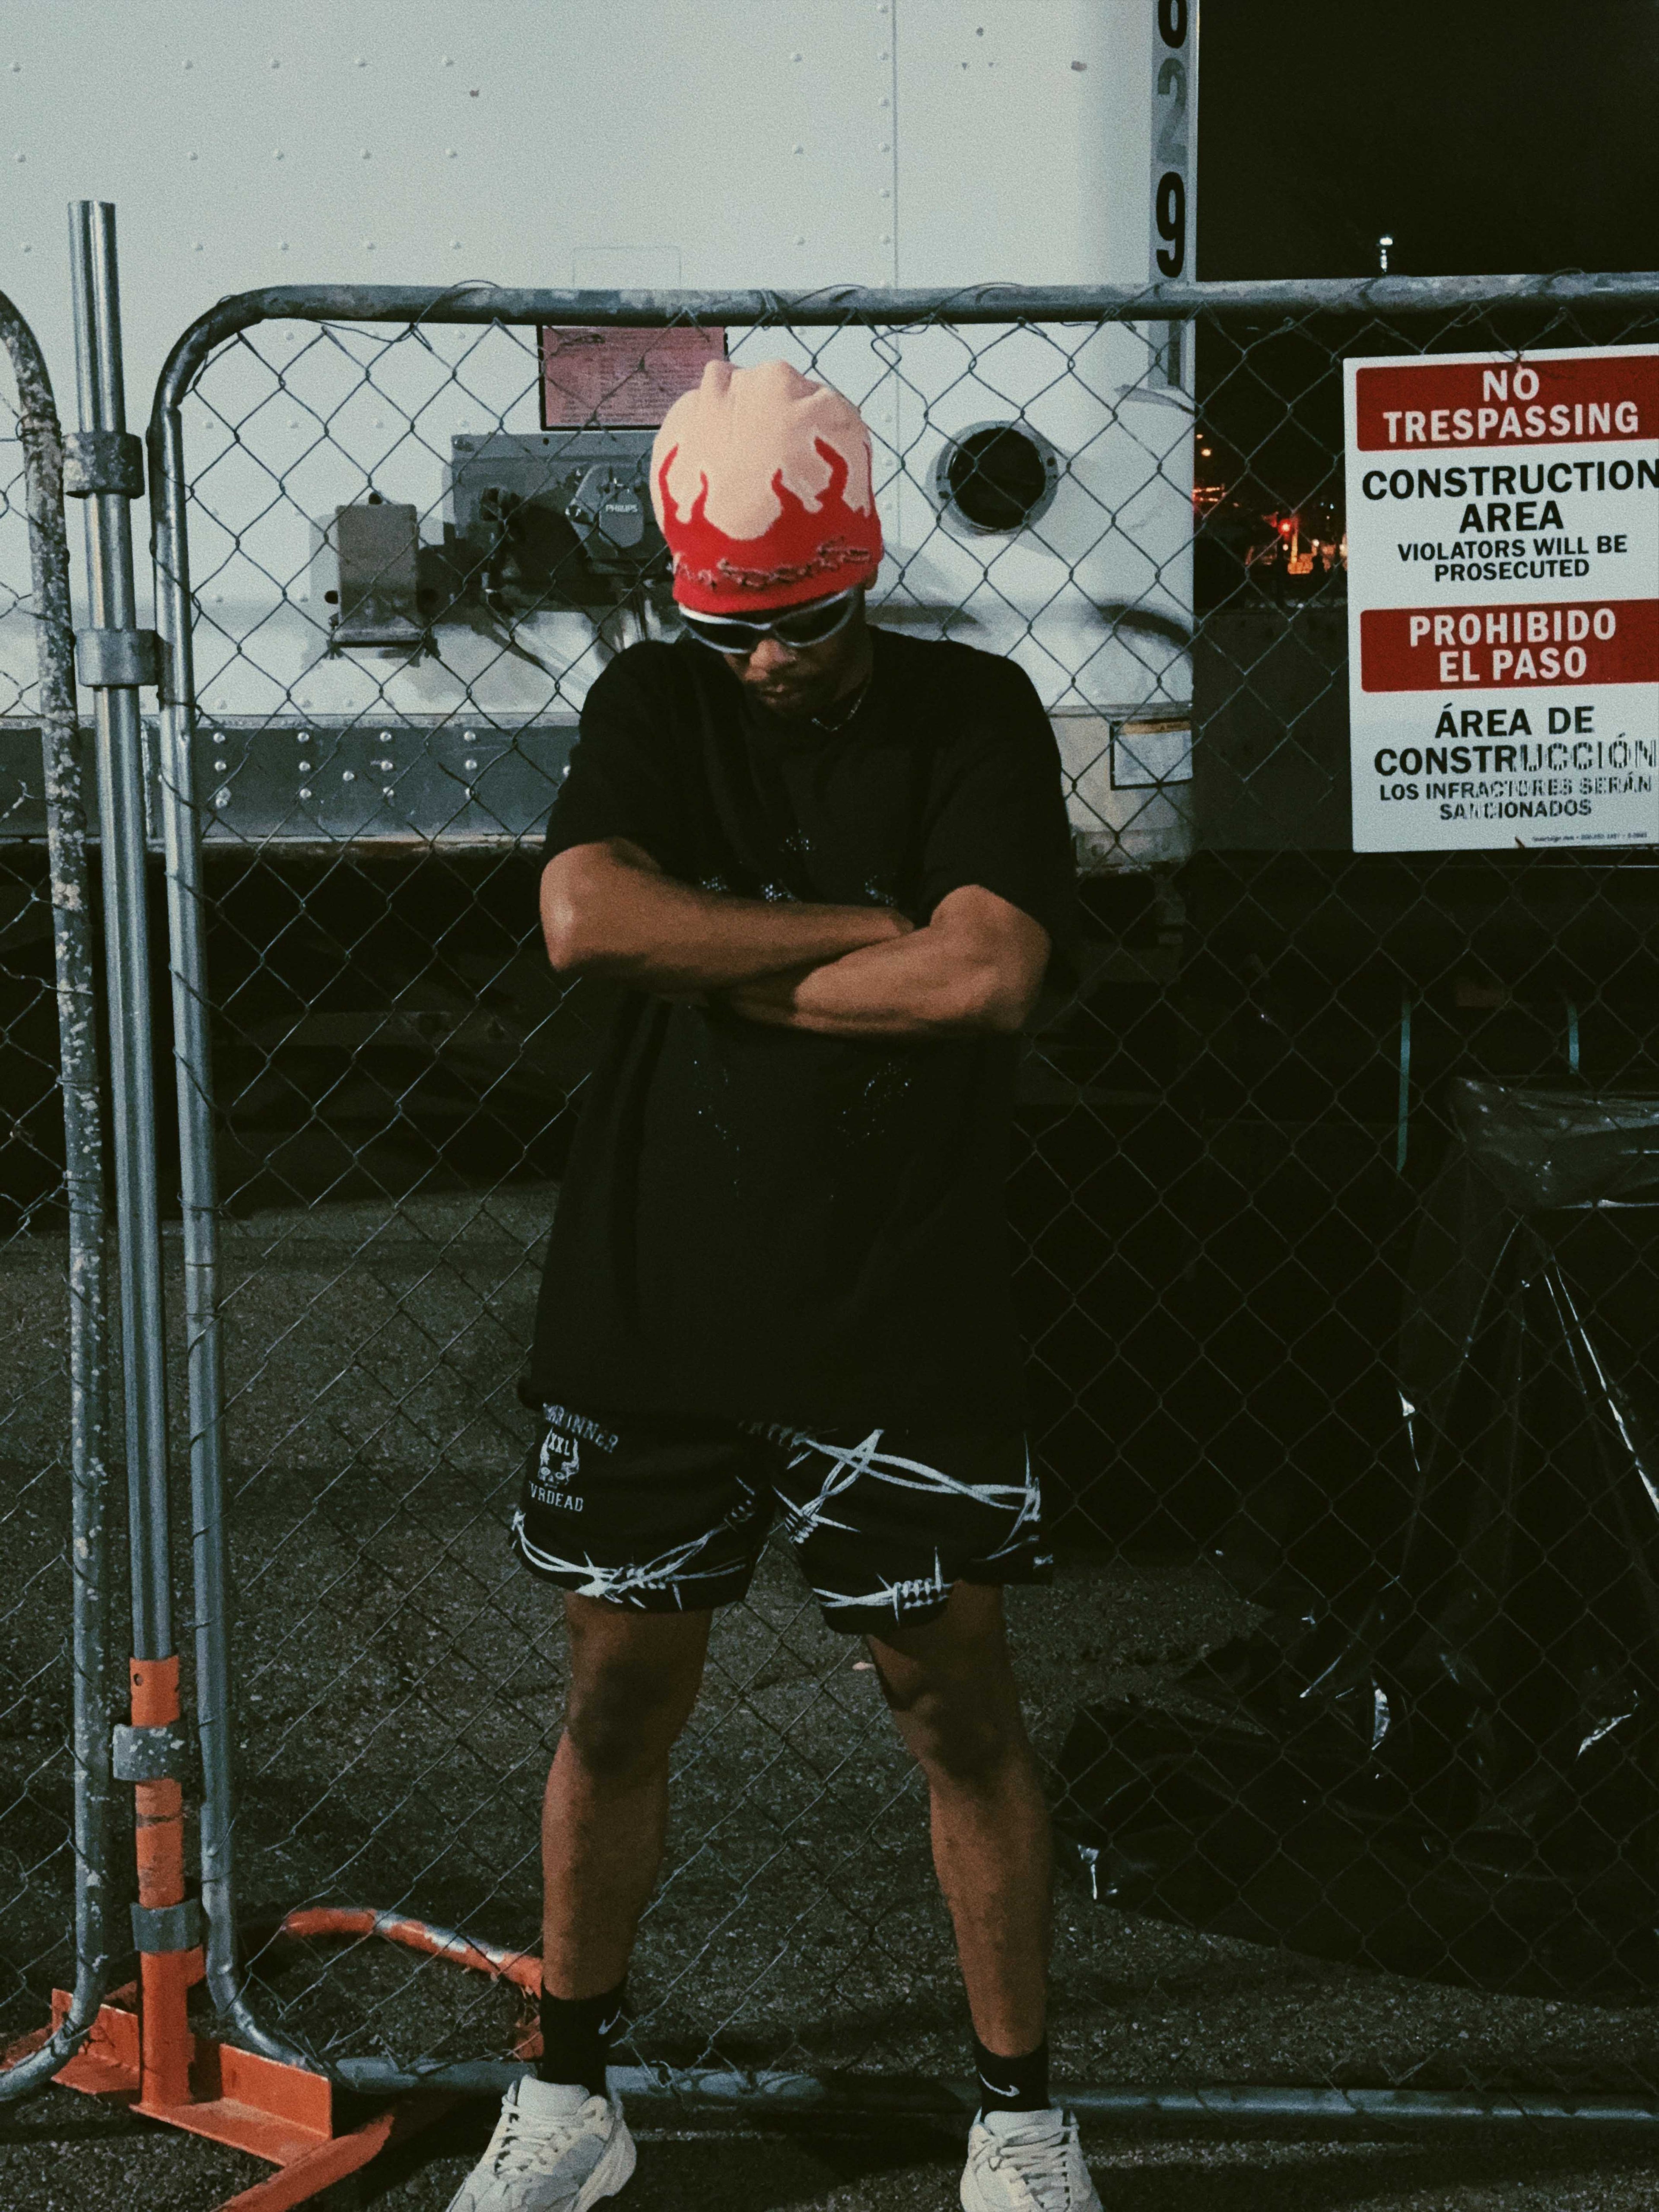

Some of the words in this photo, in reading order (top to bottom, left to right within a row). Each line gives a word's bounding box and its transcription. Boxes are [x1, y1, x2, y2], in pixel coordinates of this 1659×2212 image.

[1483, 369, 1539, 401] NO
[1383, 401, 1638, 443] TRESPASSING
[1363, 459, 1659, 500] CONSTRUCTION
[1459, 501, 1563, 533] AREA
[1398, 540, 1525, 561] VIOLATORS
[1534, 537, 1589, 556] WILL
[1598, 535, 1627, 553] BE
[1435, 559, 1589, 582] PROSECUTED
[1410, 608, 1616, 647] PROHIBIDO
[1440, 651, 1480, 682] EL
[1493, 646, 1586, 680] PASO
[1435, 703, 1532, 738] ÁREA
[1549, 706, 1594, 734] DE
[1375, 733, 1656, 776] CONSTRUCCIÓN
[1380, 785, 1419, 801] LOS
